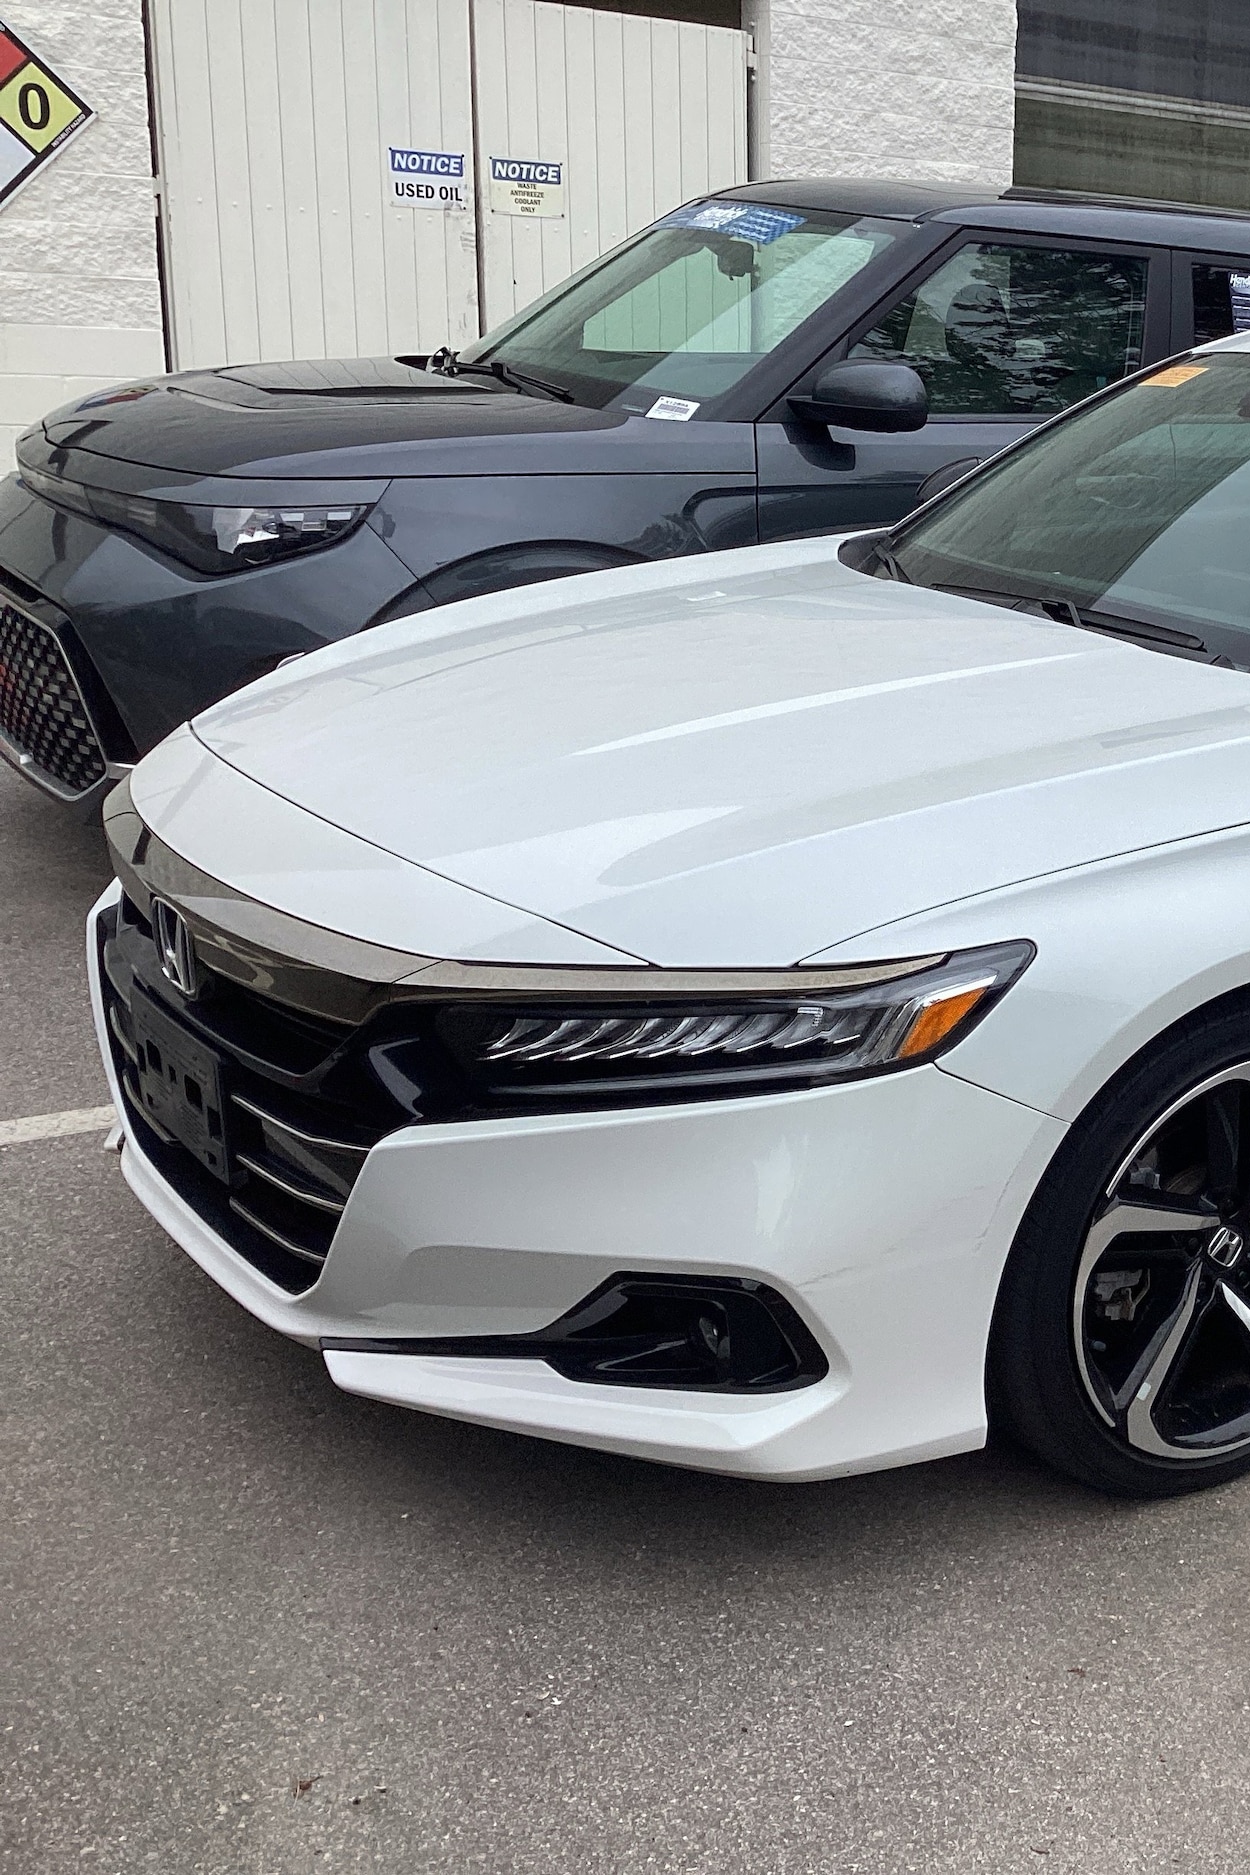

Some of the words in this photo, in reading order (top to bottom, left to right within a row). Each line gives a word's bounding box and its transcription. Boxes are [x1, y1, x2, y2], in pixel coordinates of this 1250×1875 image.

[18, 83, 50, 130] 0
[394, 153, 461, 173] NOTICE
[494, 162, 559, 181] NOTICE
[395, 182, 434, 199] USED
[439, 186, 463, 202] OIL
[510, 190, 544, 198] ANTIFREEZE
